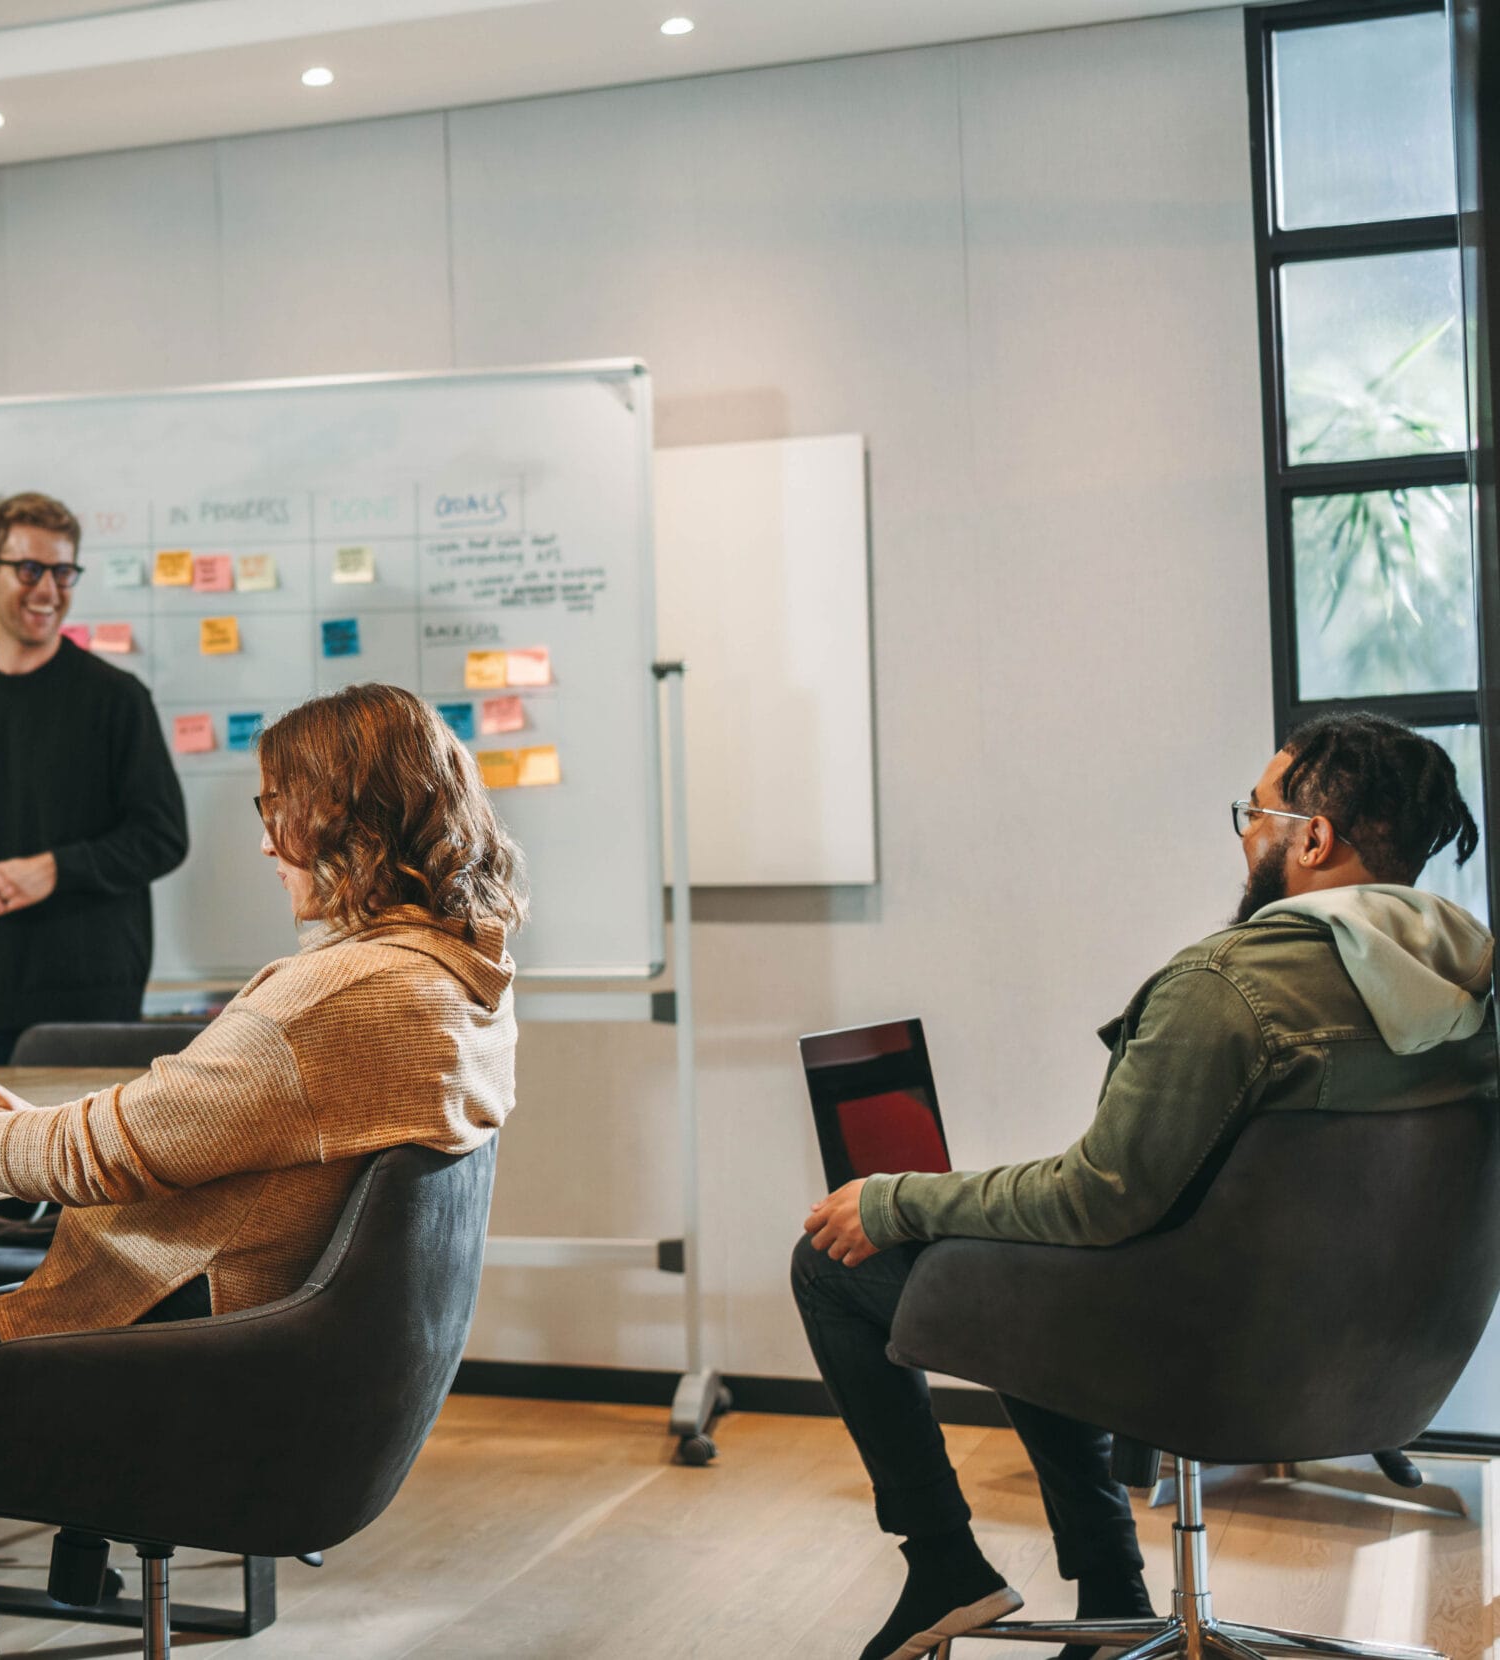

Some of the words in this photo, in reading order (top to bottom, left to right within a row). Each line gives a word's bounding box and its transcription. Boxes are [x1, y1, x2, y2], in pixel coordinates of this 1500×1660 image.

[168, 505, 189, 526] IN
[199, 498, 291, 525] PROGRESS
[435, 493, 507, 519] GOALS
